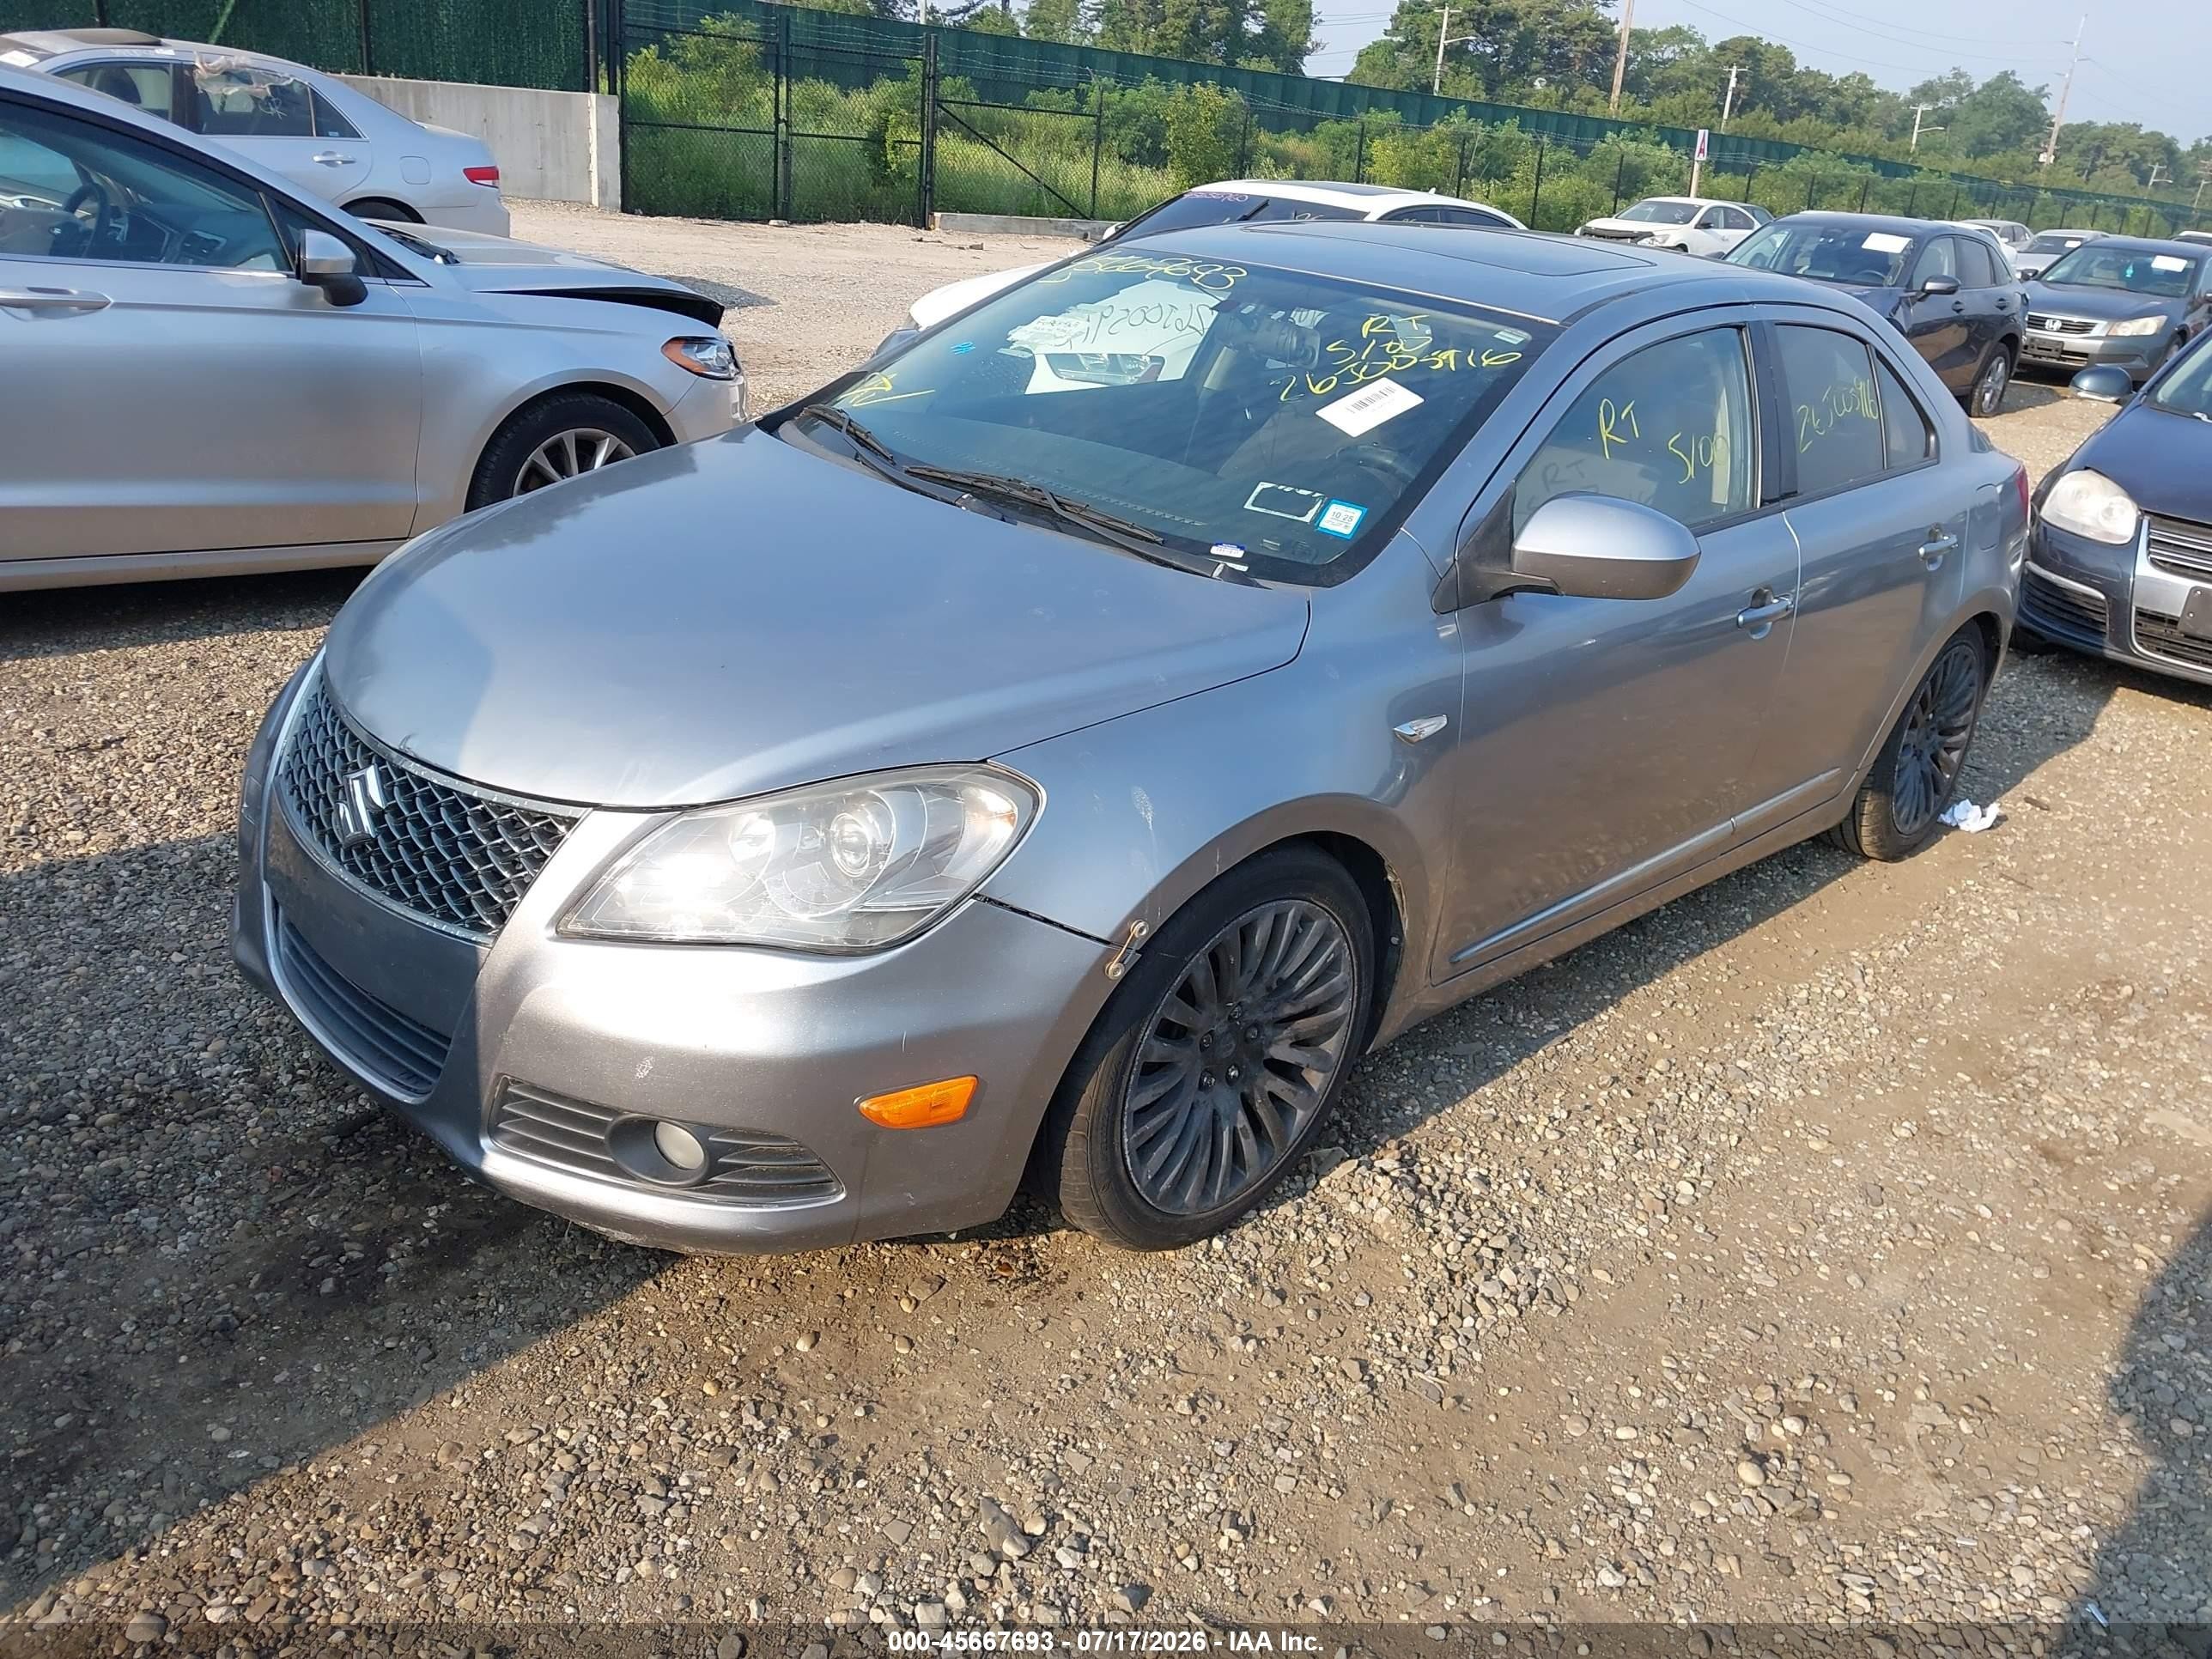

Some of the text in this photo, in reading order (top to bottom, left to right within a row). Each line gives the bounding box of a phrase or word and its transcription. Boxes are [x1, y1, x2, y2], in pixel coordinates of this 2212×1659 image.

[1697, 130, 1706, 158] A
[1360, 314, 1430, 338] RT
[1599, 398, 1639, 460] RT
